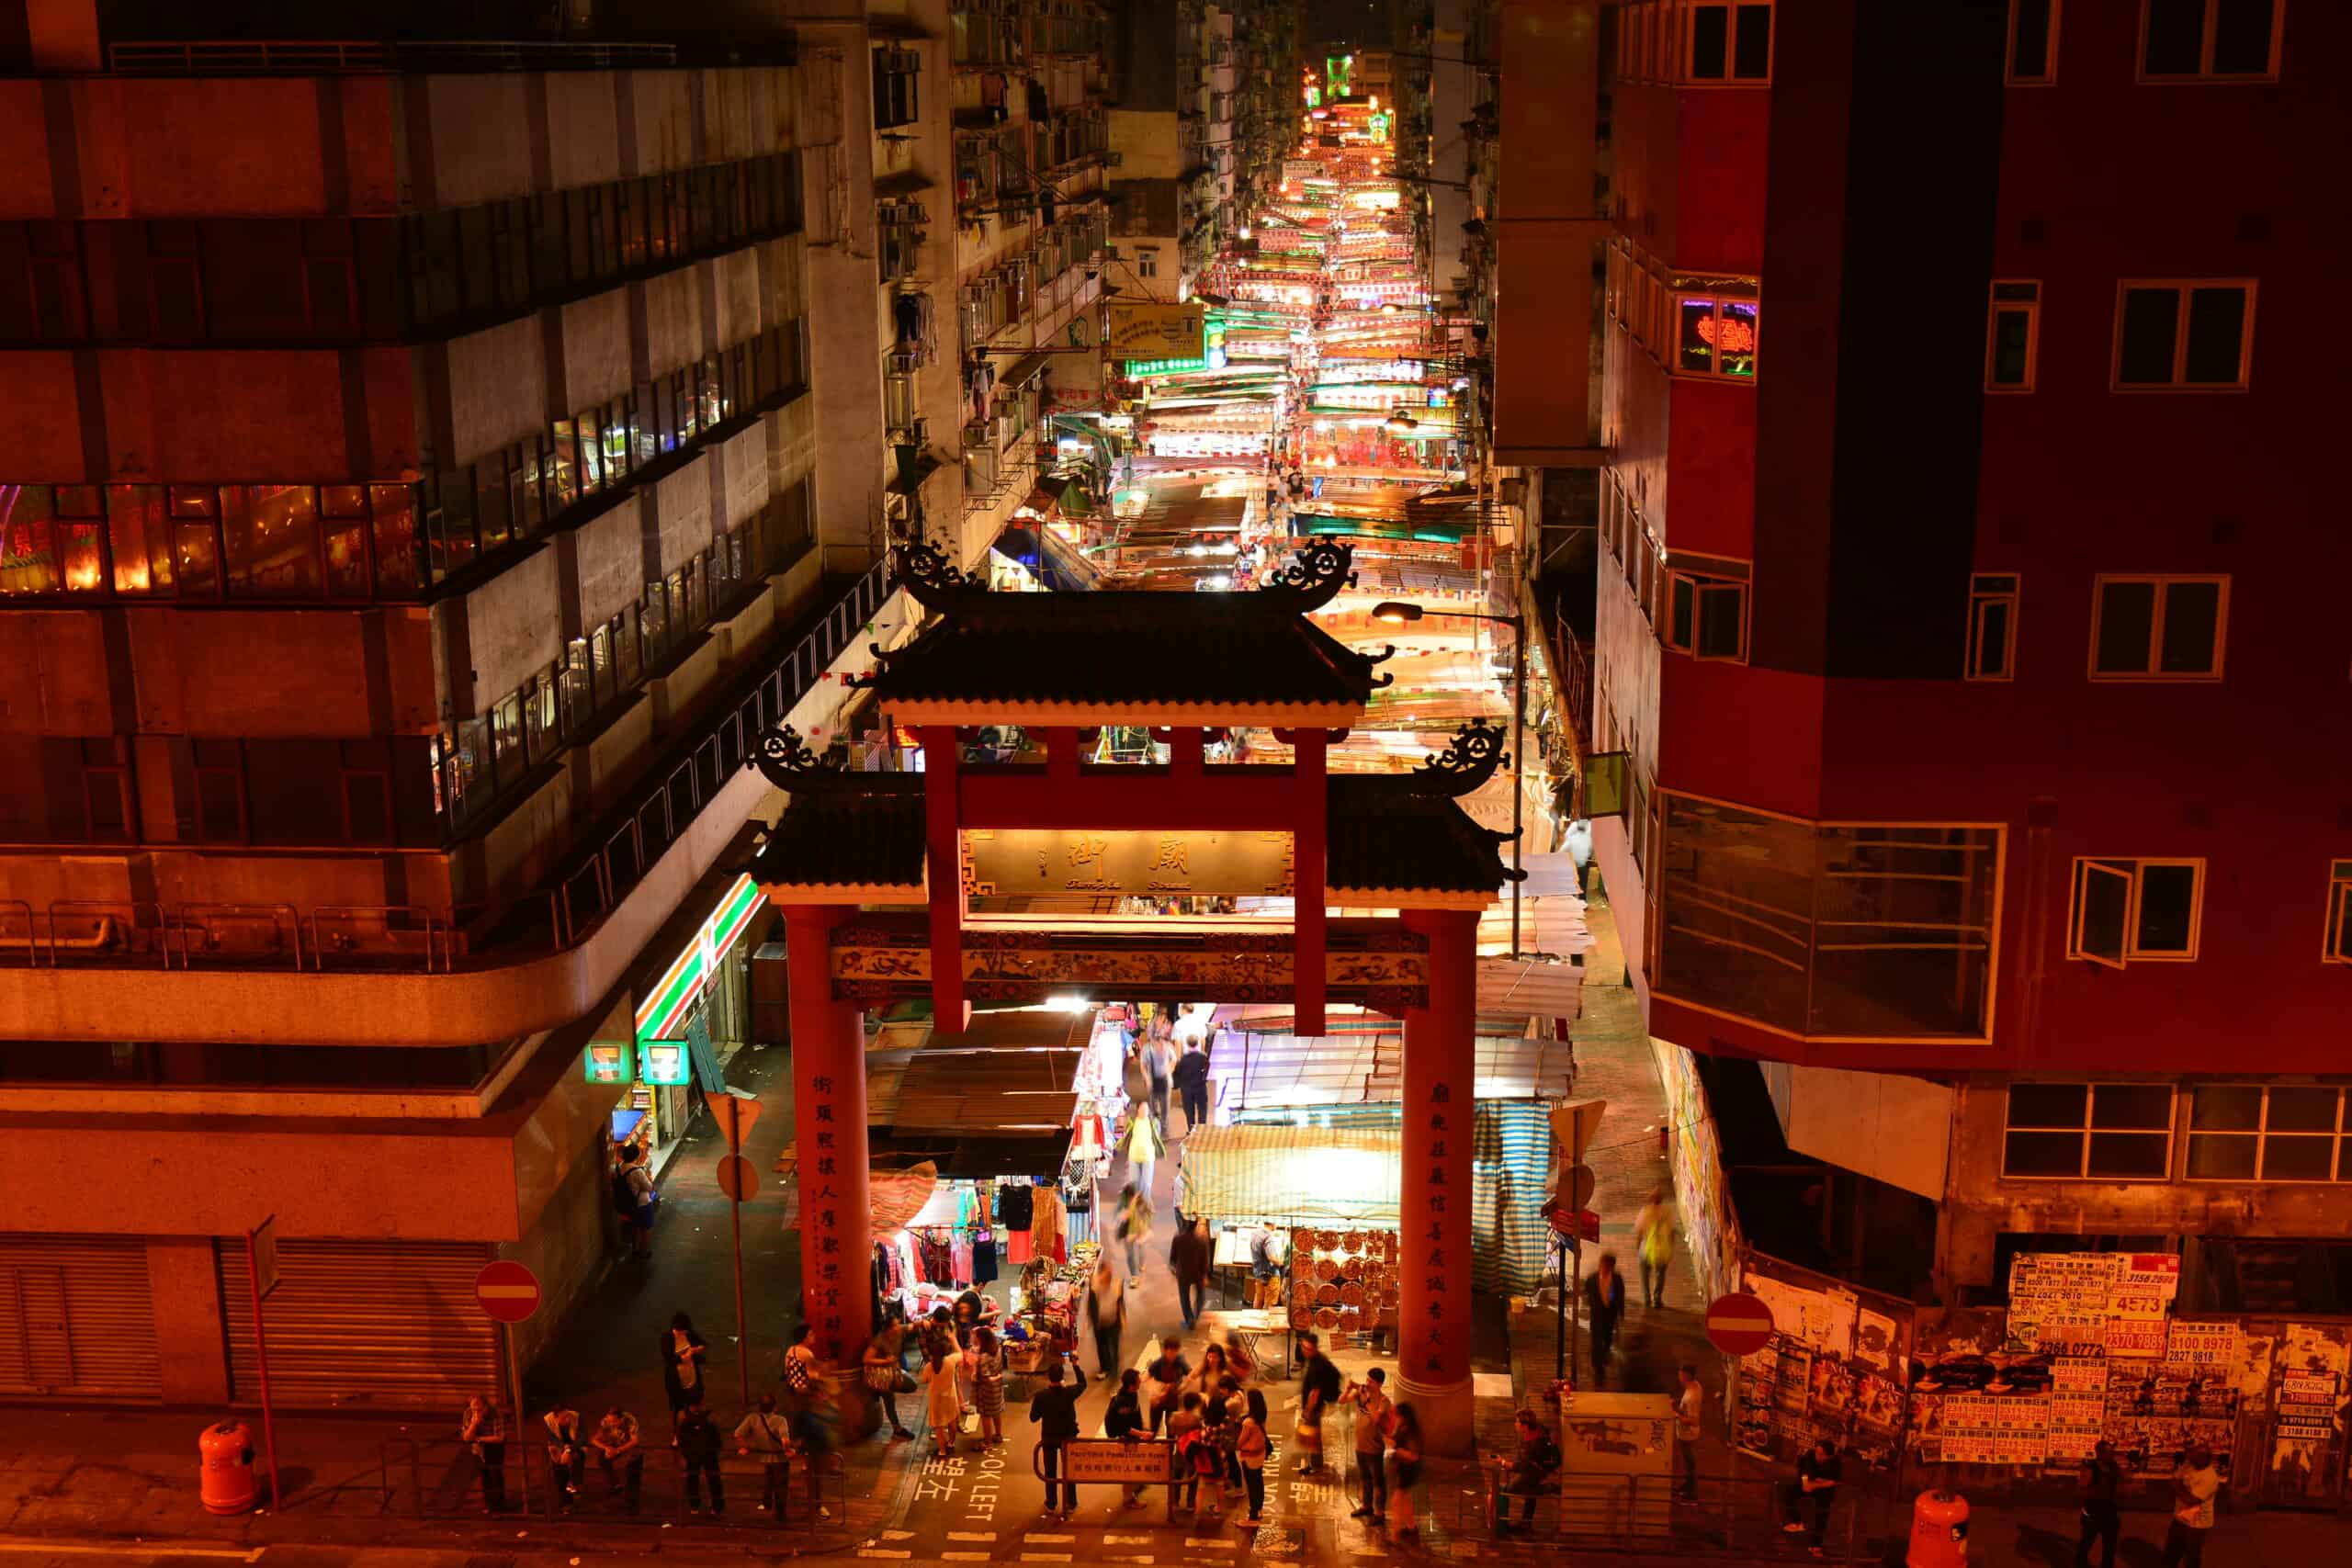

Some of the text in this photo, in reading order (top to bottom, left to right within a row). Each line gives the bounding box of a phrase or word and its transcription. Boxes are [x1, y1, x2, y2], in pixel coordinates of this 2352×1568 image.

[2039, 1341, 2103, 1357] 2366 0772
[2107, 1336, 2133, 1348] 2370
[2170, 1337, 2233, 1350] 8100 8978
[914, 1455, 970, 1502] 望左
[965, 1485, 1001, 1522] LEFT
